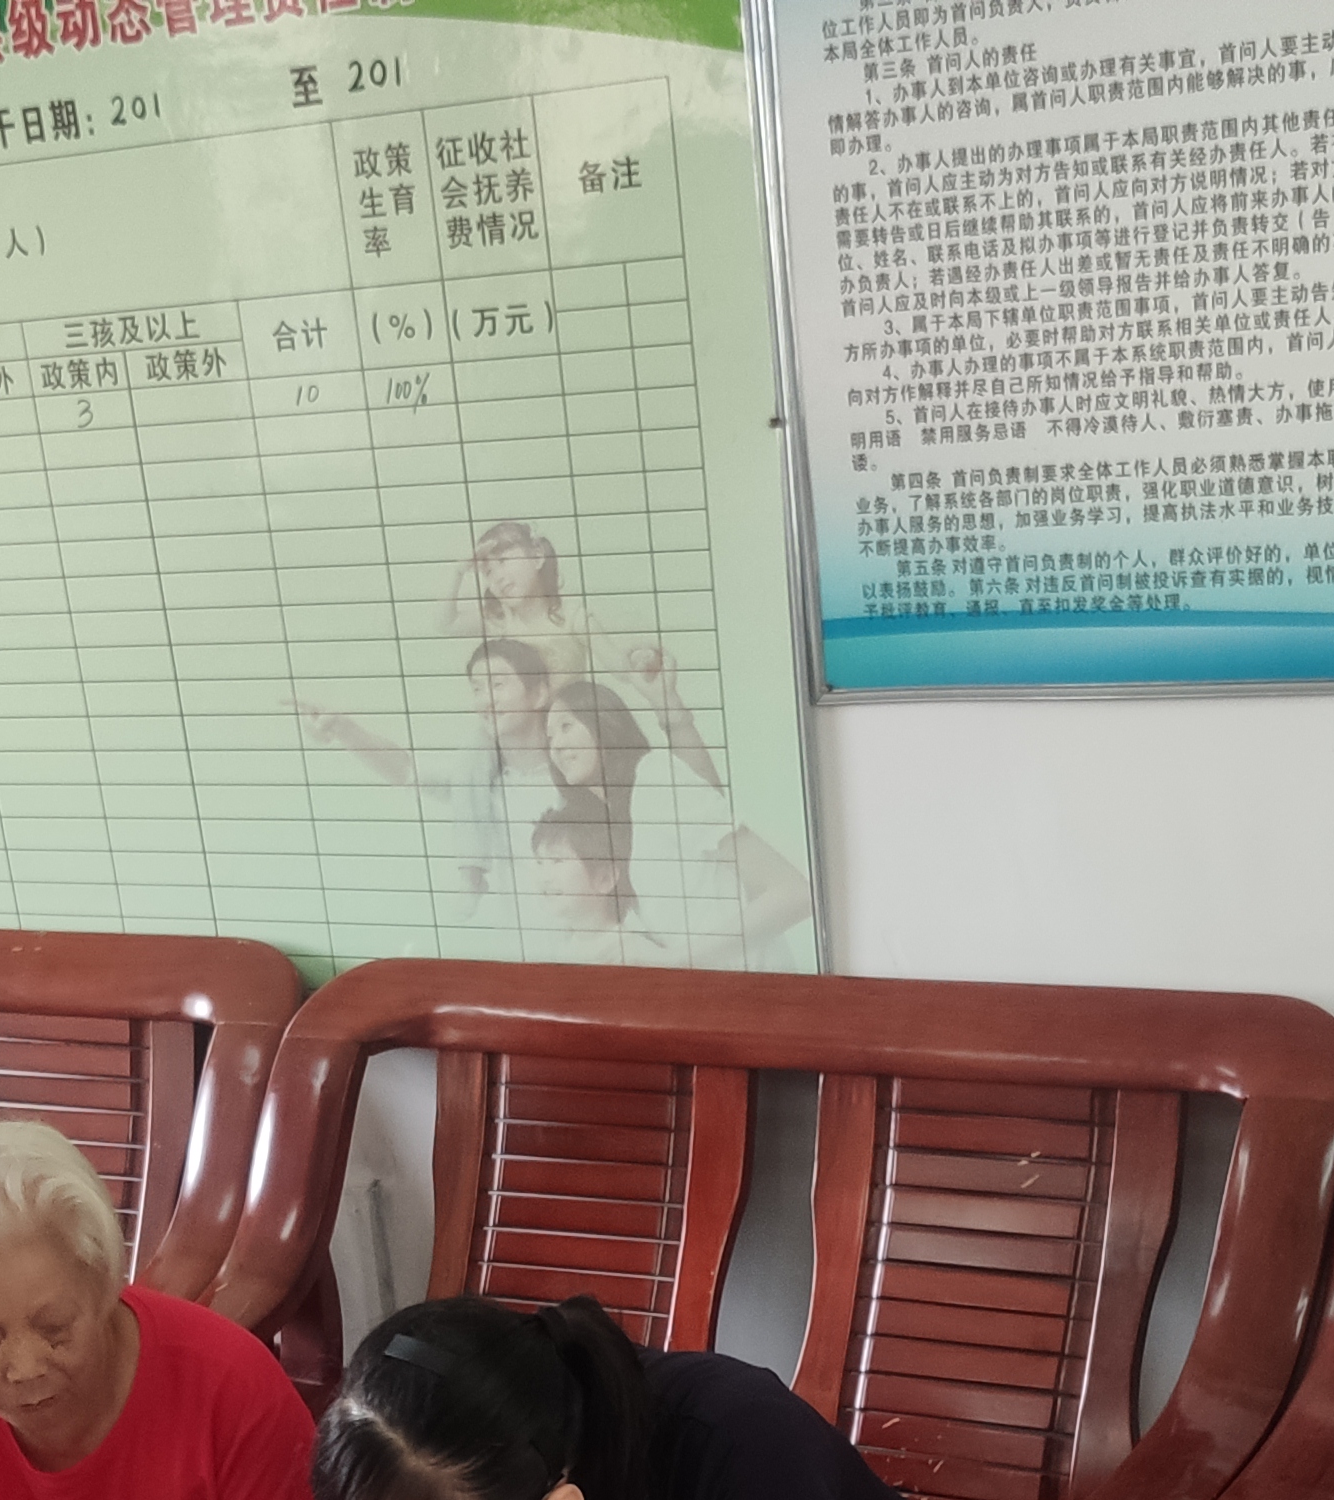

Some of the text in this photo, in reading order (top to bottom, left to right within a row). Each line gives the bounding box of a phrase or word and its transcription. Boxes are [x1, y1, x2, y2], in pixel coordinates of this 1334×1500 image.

[824, 27, 978, 63] 本局全体工作人员。
[864, 43, 1037, 84] 第三条 首问人的责任
[111, 91, 162, 128] 201
[291, 64, 324, 107] 至
[348, 57, 404, 93] 201
[353, 143, 412, 180] 政策
[436, 127, 532, 170] 征收社
[830, 134, 892, 156] 即办理。
[441, 167, 535, 211] 会抚养
[578, 156, 642, 196] 备注
[359, 181, 415, 220] 生育
[364, 224, 393, 257] 率
[447, 209, 540, 250] 费情况
[65, 312, 199, 350] 三孩及以上
[272, 318, 328, 352] 合计
[40, 357, 120, 391] 政策内
[146, 350, 227, 381] 政策外
[295, 383, 319, 406] 10
[385, 371, 431, 414] 100%
[77, 399, 94, 428] 3
[891, 472, 941, 491] 第四条
